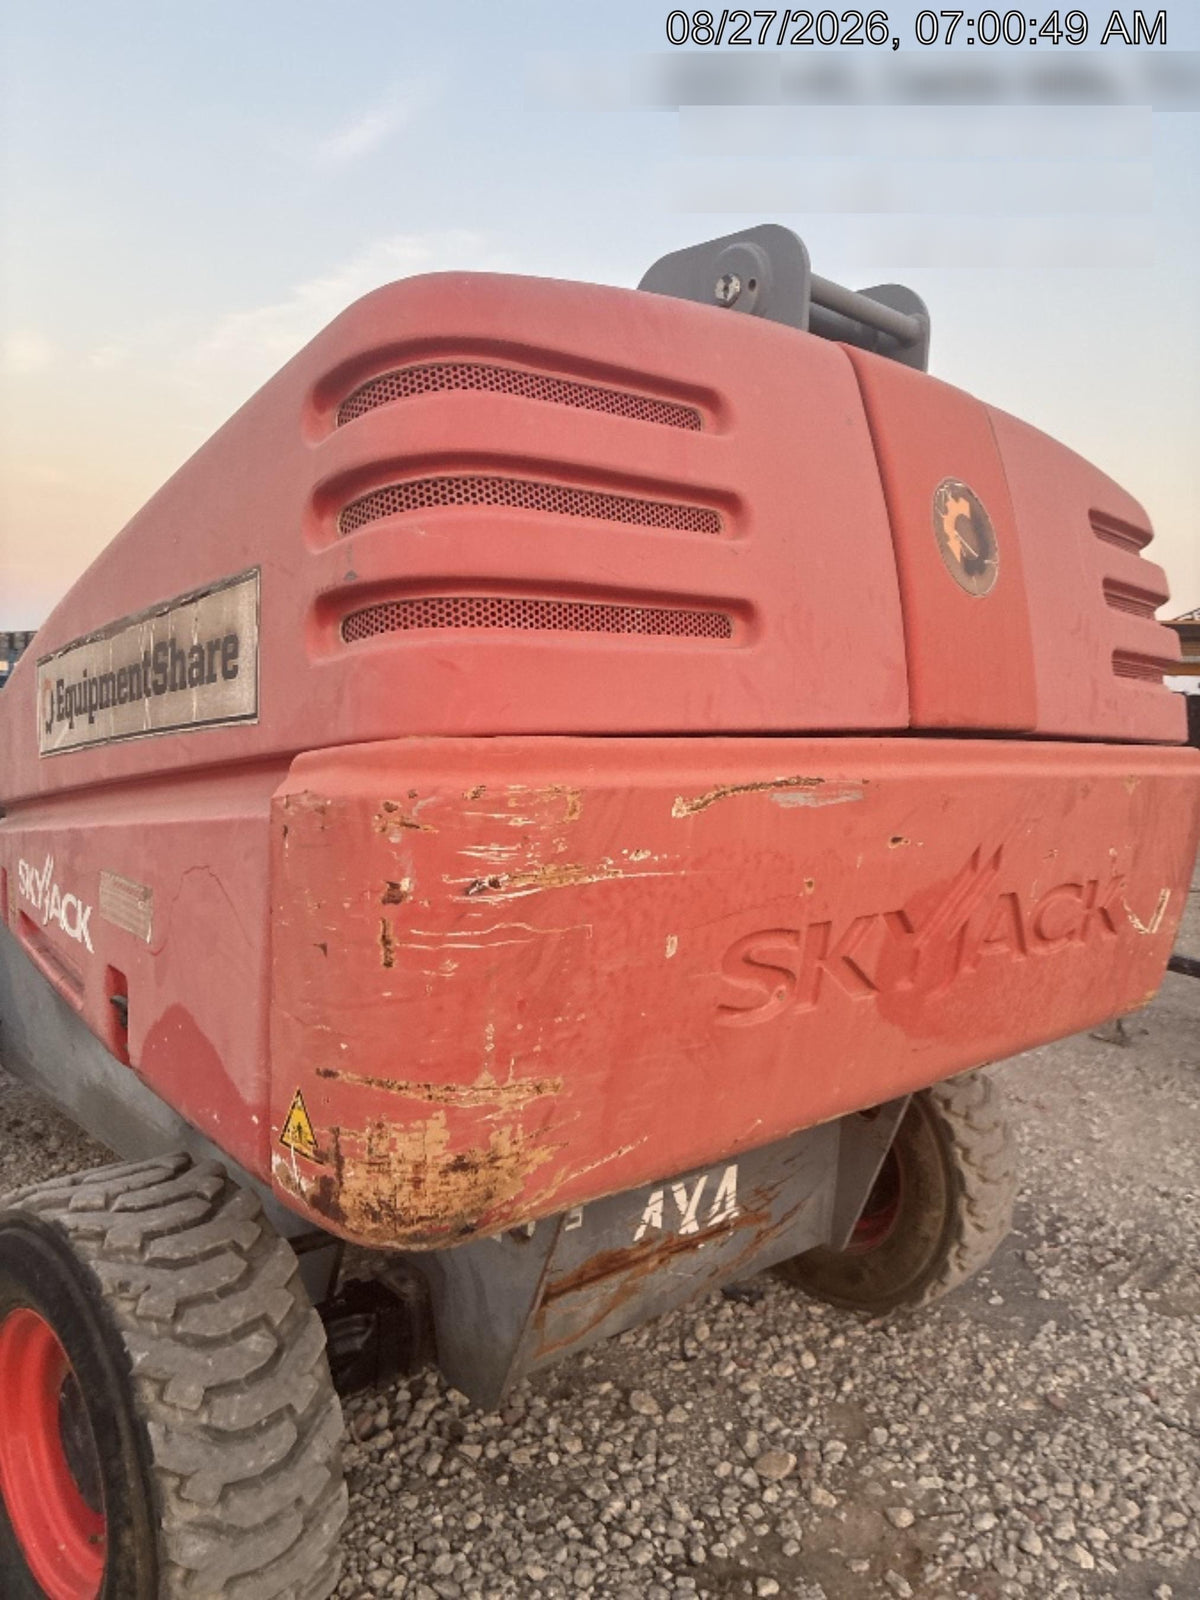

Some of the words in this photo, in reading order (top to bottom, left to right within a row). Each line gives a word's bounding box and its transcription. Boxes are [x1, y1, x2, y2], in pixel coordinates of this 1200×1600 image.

[56, 631, 240, 730] EquipmentShare
[18, 852, 95, 954] SKYJACK
[714, 843, 1127, 1028] SKYJACK
